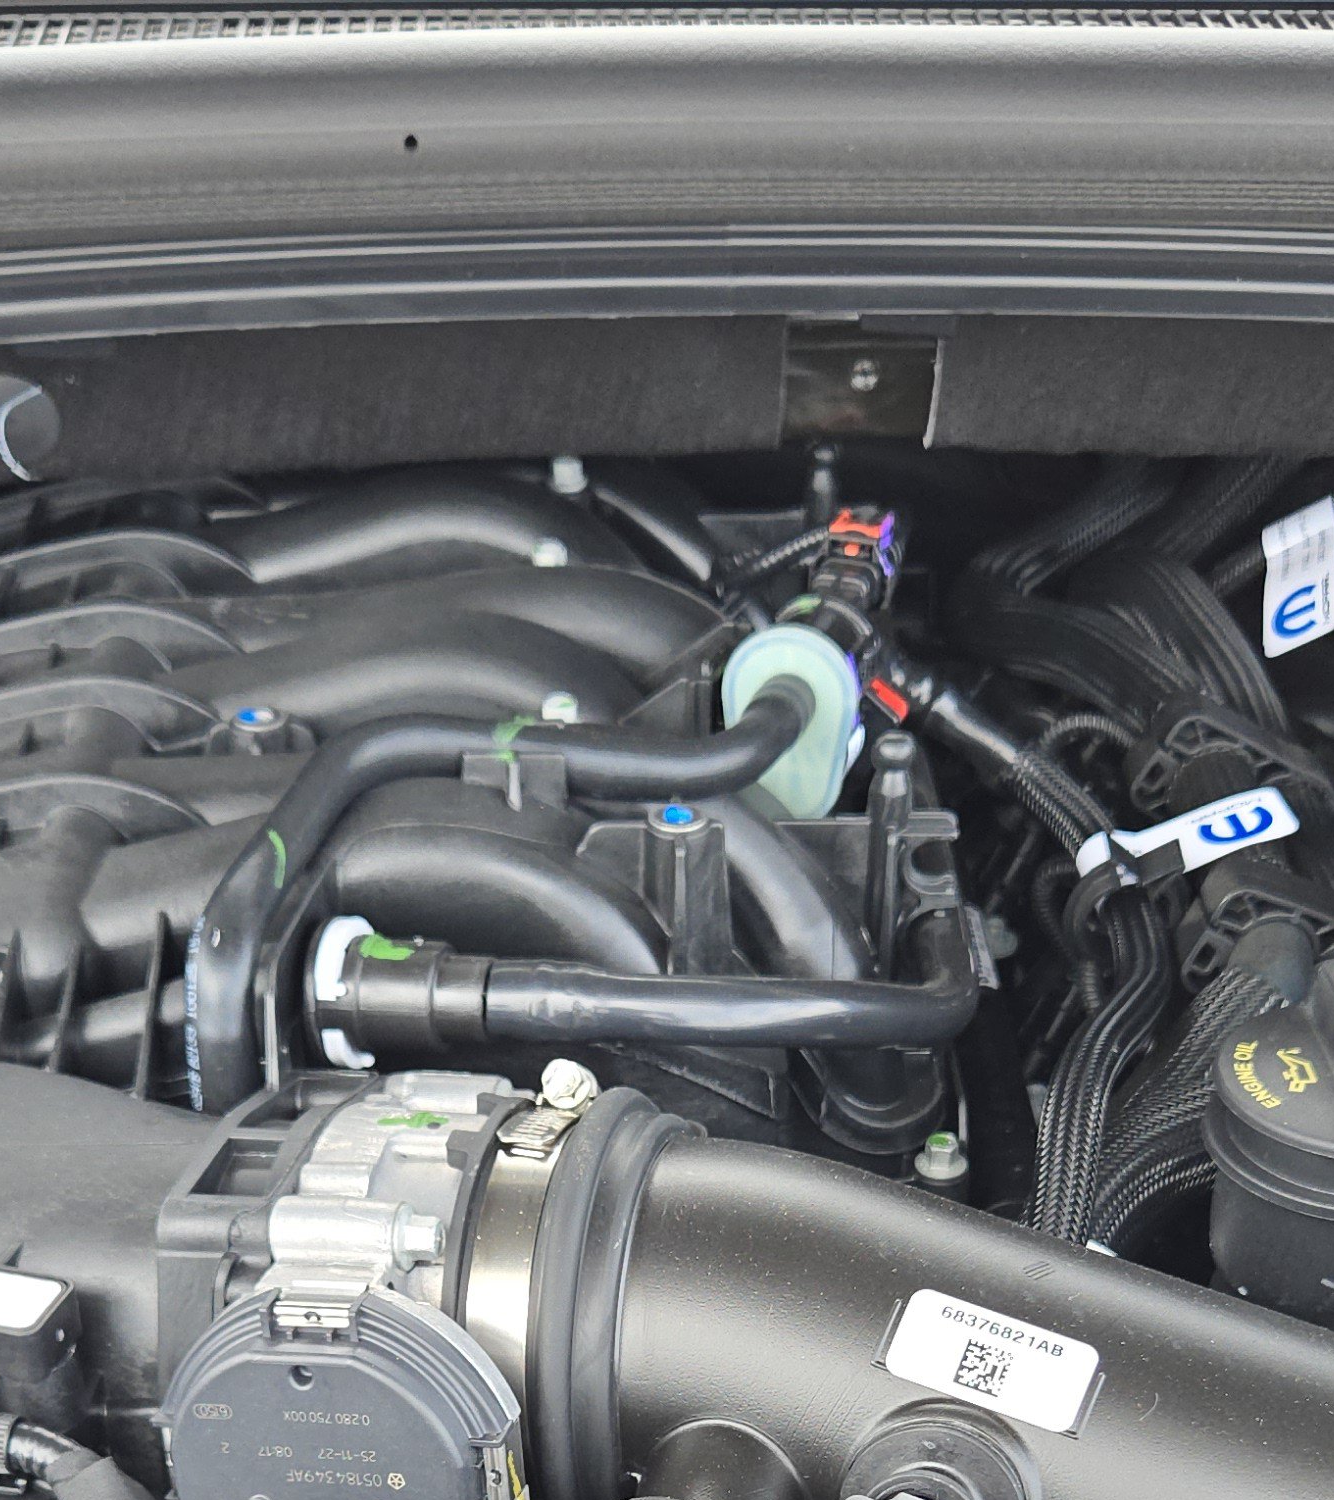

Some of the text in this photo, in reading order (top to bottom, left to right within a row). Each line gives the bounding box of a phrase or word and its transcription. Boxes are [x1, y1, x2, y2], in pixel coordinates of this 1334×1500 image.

[1233, 1039, 1281, 1108] ENGINE OIL
[941, 1305, 1065, 1358] 68376821AB
[317, 1447, 376, 1462] 25-11-27
[285, 1468, 382, 1488] 05184349AF
